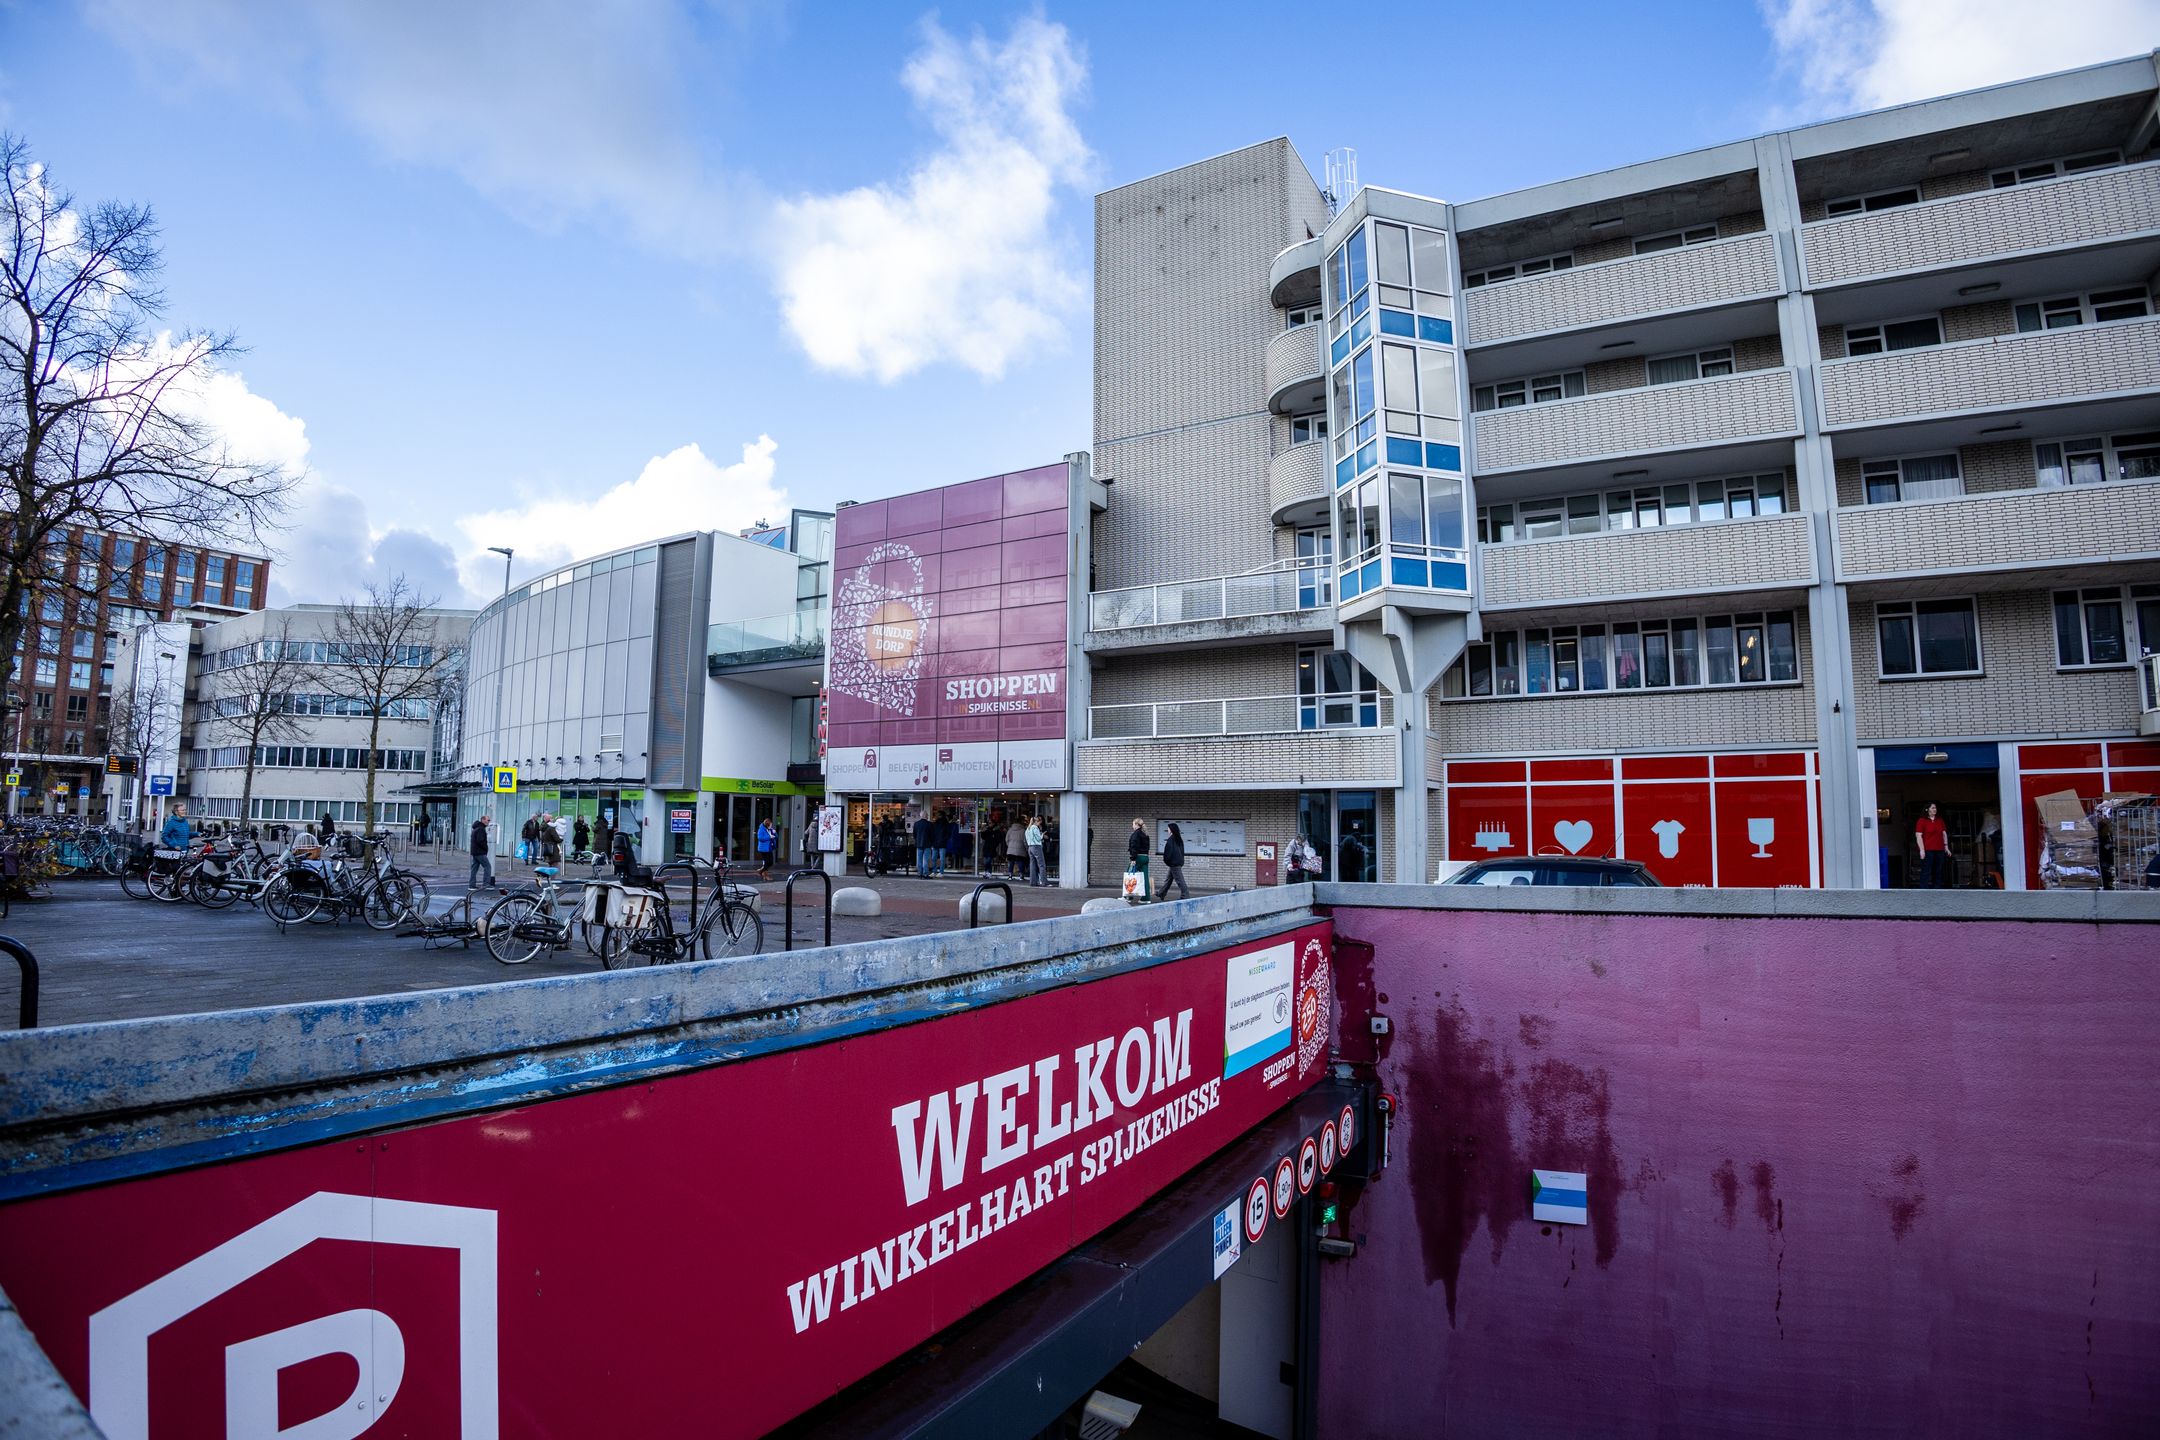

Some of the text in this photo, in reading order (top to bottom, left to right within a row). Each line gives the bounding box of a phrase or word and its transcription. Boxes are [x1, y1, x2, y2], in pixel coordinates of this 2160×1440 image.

[872, 625, 913, 640] RONDJE
[875, 639, 905, 652] DORP
[946, 673, 1057, 700] SHOPPEN
[817, 687, 828, 759] HEMA
[832, 763, 868, 774] SHOPPEN
[888, 763, 925, 773] BELEVEN
[939, 761, 996, 772] ONTMOETEN
[1013, 759, 1057, 770] PROEVEN
[752, 780, 775, 789] BeSolar
[1248, 961, 1276, 976] NISSEWAARD
[1302, 996, 1316, 1031] 250
[1263, 1052, 1296, 1083] SHOPPEN
[892, 1008, 1193, 1207] WELKOM
[787, 1077, 1221, 1335] WINKELHART SPIJKENISSE
[1252, 1195, 1264, 1224] 15
[1215, 1219, 1232, 1244] ALLEEN
[1215, 1234, 1232, 1259] PINNEN
[226, 1308, 405, 1440] P
